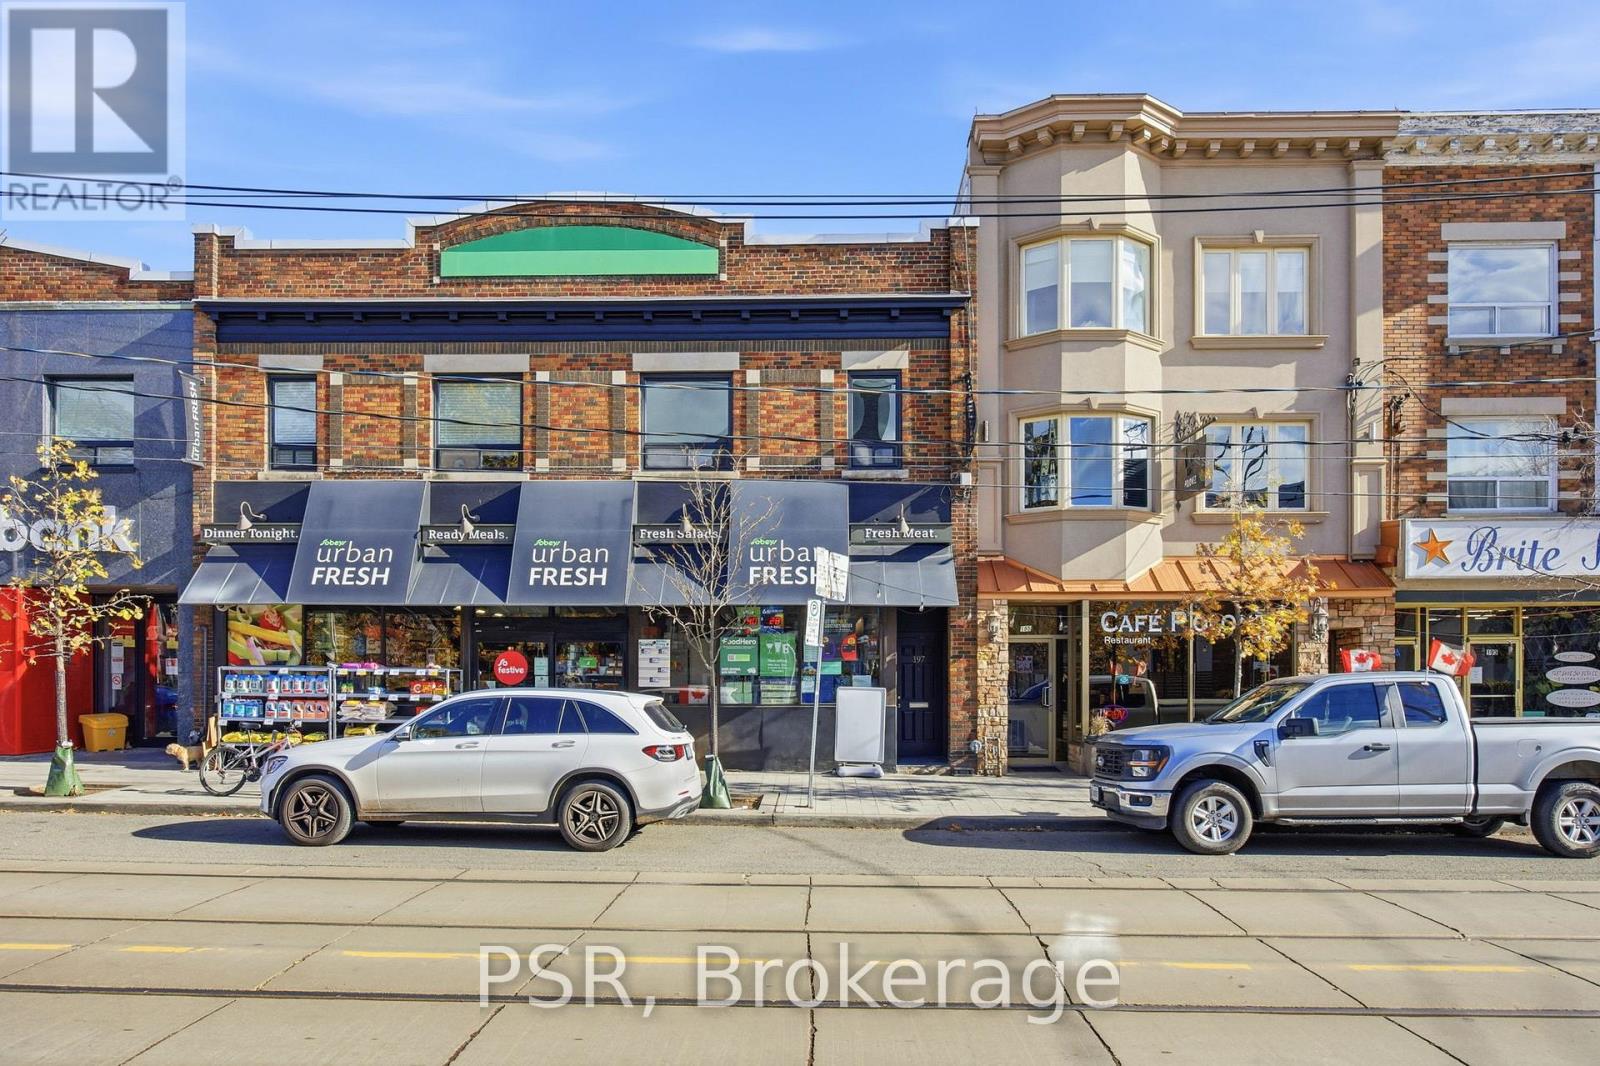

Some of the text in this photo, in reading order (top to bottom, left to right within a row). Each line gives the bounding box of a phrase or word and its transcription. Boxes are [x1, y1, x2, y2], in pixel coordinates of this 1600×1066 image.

[189, 381, 199, 421] FRESH
[203, 528, 299, 541] Dinner Tonight.
[428, 529, 508, 541] Ready Meals.
[640, 529, 674, 539] Fresh
[864, 528, 938, 539] Fresh Meat.
[316, 541, 393, 563] urban
[532, 541, 609, 563] urban
[1461, 526, 1567, 572] Brite
[311, 567, 390, 585] FRESH
[528, 567, 607, 586] FRESH
[1104, 635, 1152, 645] Restaurant
[498, 665, 525, 674] festive
